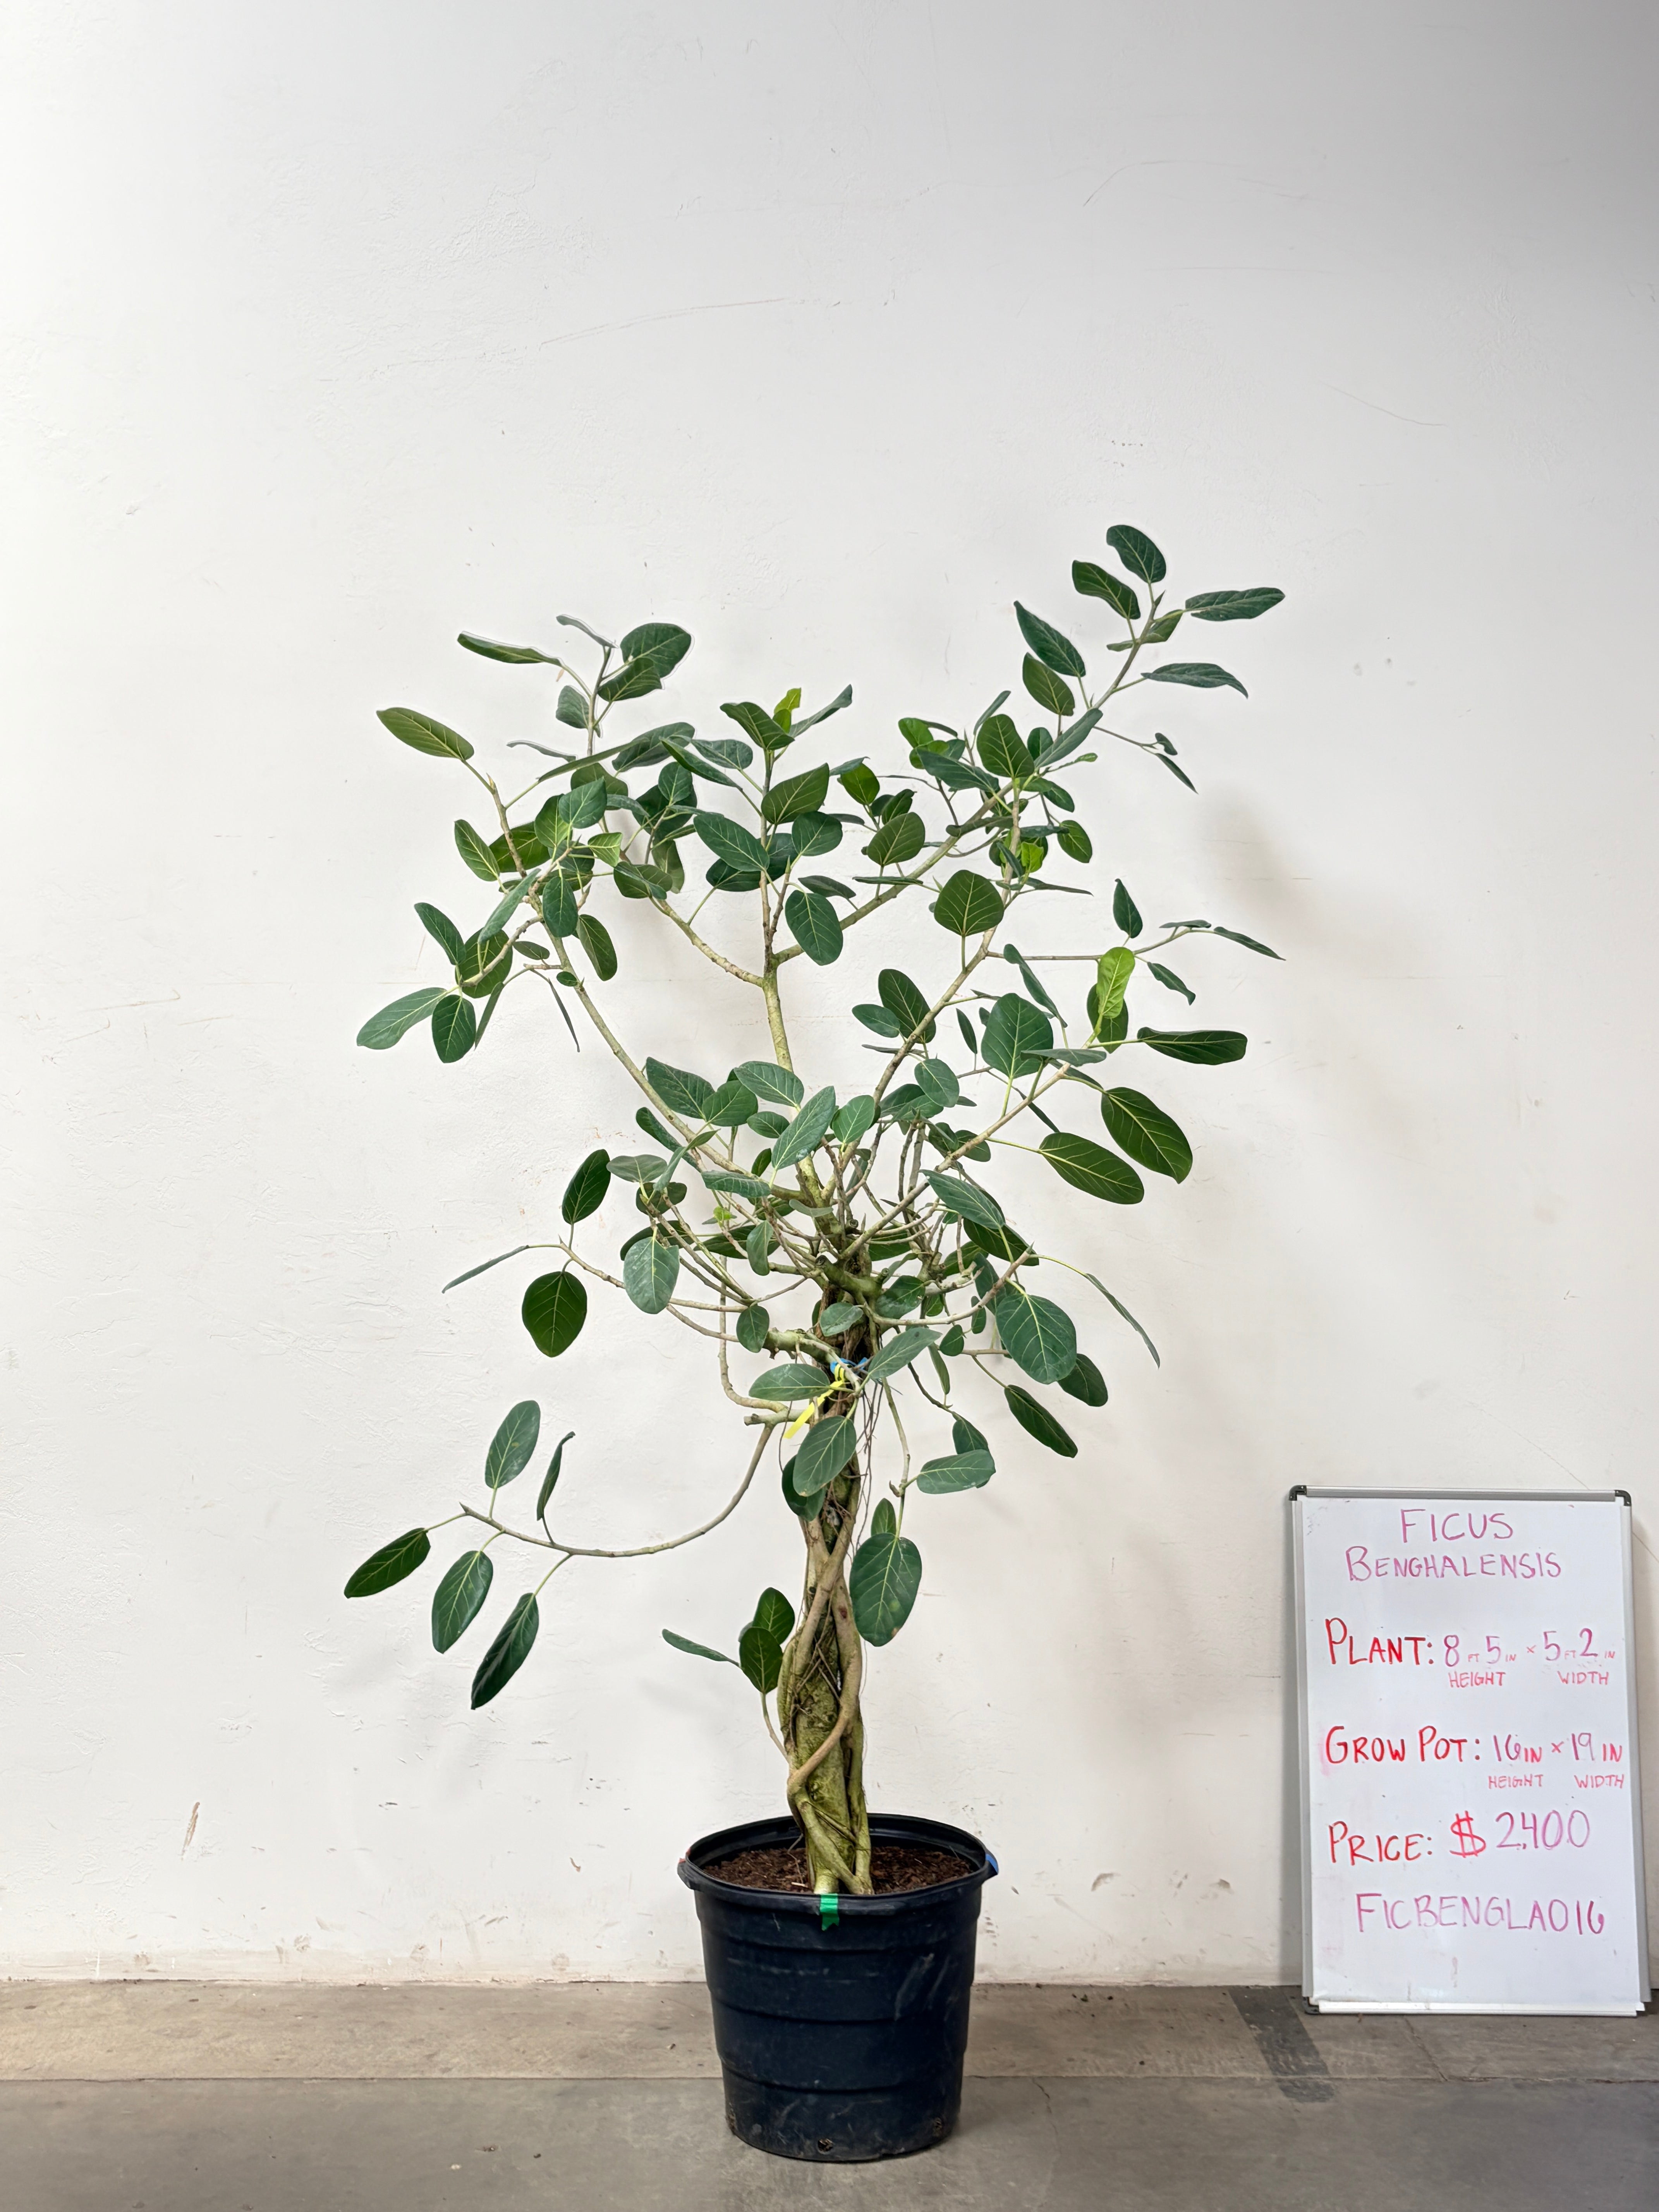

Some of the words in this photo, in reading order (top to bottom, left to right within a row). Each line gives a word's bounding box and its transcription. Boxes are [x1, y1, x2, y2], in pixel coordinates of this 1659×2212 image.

[1400, 1509, 1513, 1543] FICUS
[1345, 1546, 1561, 1582] BENGHALENSIS
[1325, 1618, 1434, 1666] PLANT:
[1444, 1635, 1460, 1668] 8
[1486, 1635, 1501, 1664] 5
[1543, 1631, 1561, 1661] 5
[1579, 1628, 1599, 1658] 2
[1448, 1671, 1506, 1688] HEIGHT
[1557, 1671, 1609, 1685] WIDTH
[1326, 1726, 1406, 1764] GROW
[1418, 1725, 1480, 1763] POT:
[1488, 1774, 1543, 1789] HEIGHT
[1574, 1774, 1625, 1789] WIDTH
[1328, 1820, 1432, 1866] PRICE:
